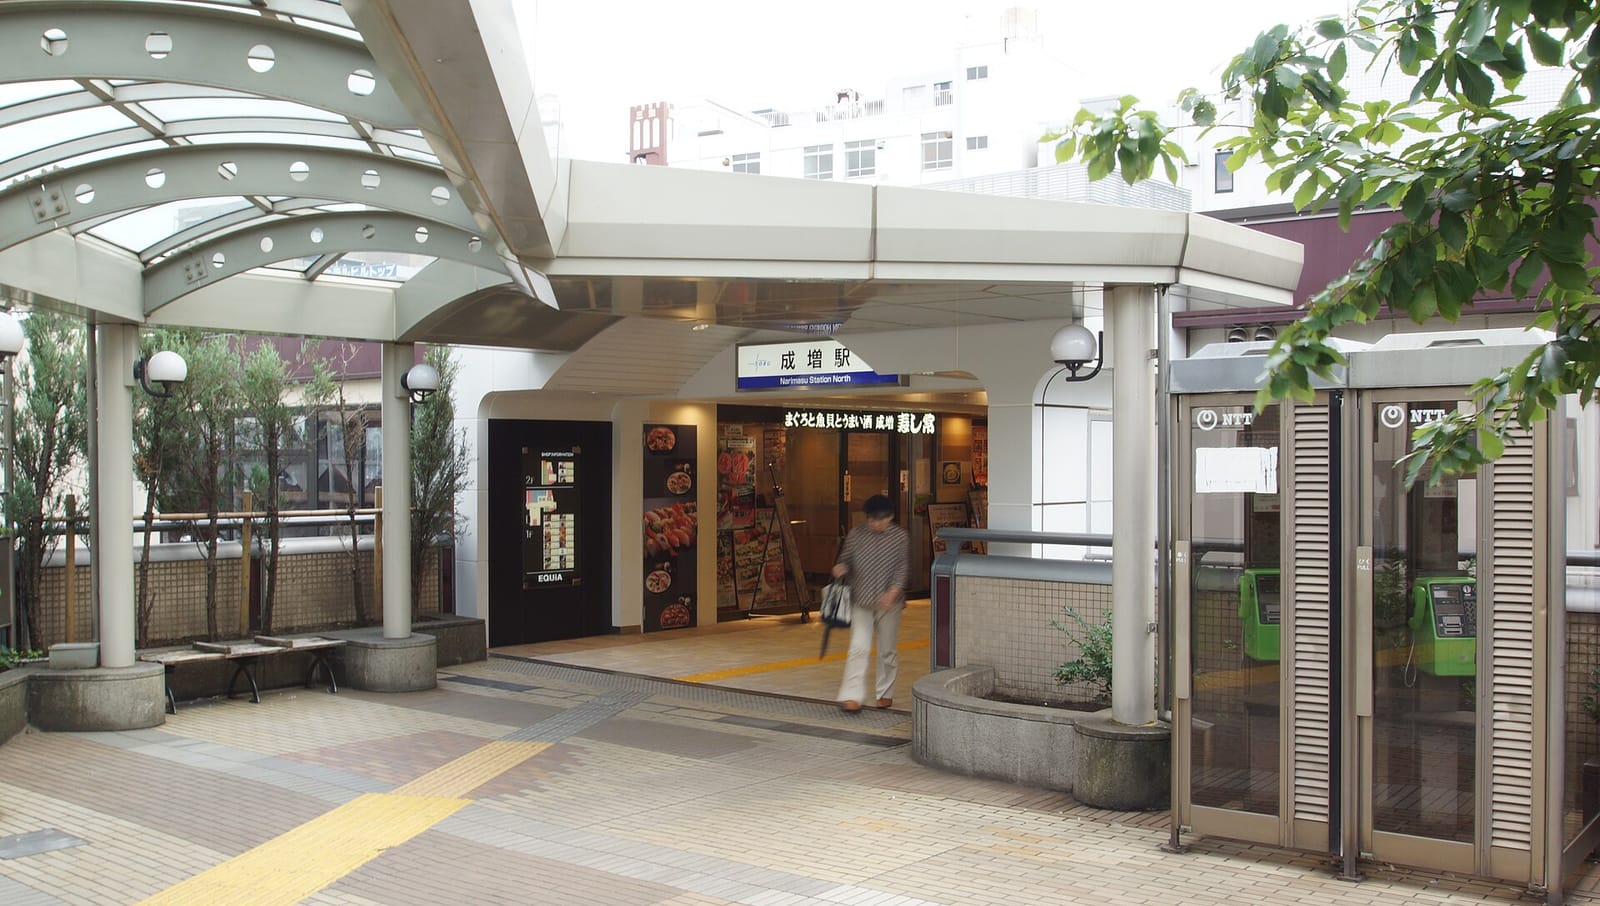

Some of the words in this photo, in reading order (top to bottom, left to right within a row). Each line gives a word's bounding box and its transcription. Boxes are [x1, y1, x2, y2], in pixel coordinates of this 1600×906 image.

[781, 348, 850, 370] 成増駅
[780, 377, 808, 385] Narimasu
[809, 376, 831, 384] Station
[833, 375, 851, 383] North
[1222, 413, 1252, 425] NTT
[1410, 409, 1445, 422] NTT
[538, 573, 563, 583] EQUIA
